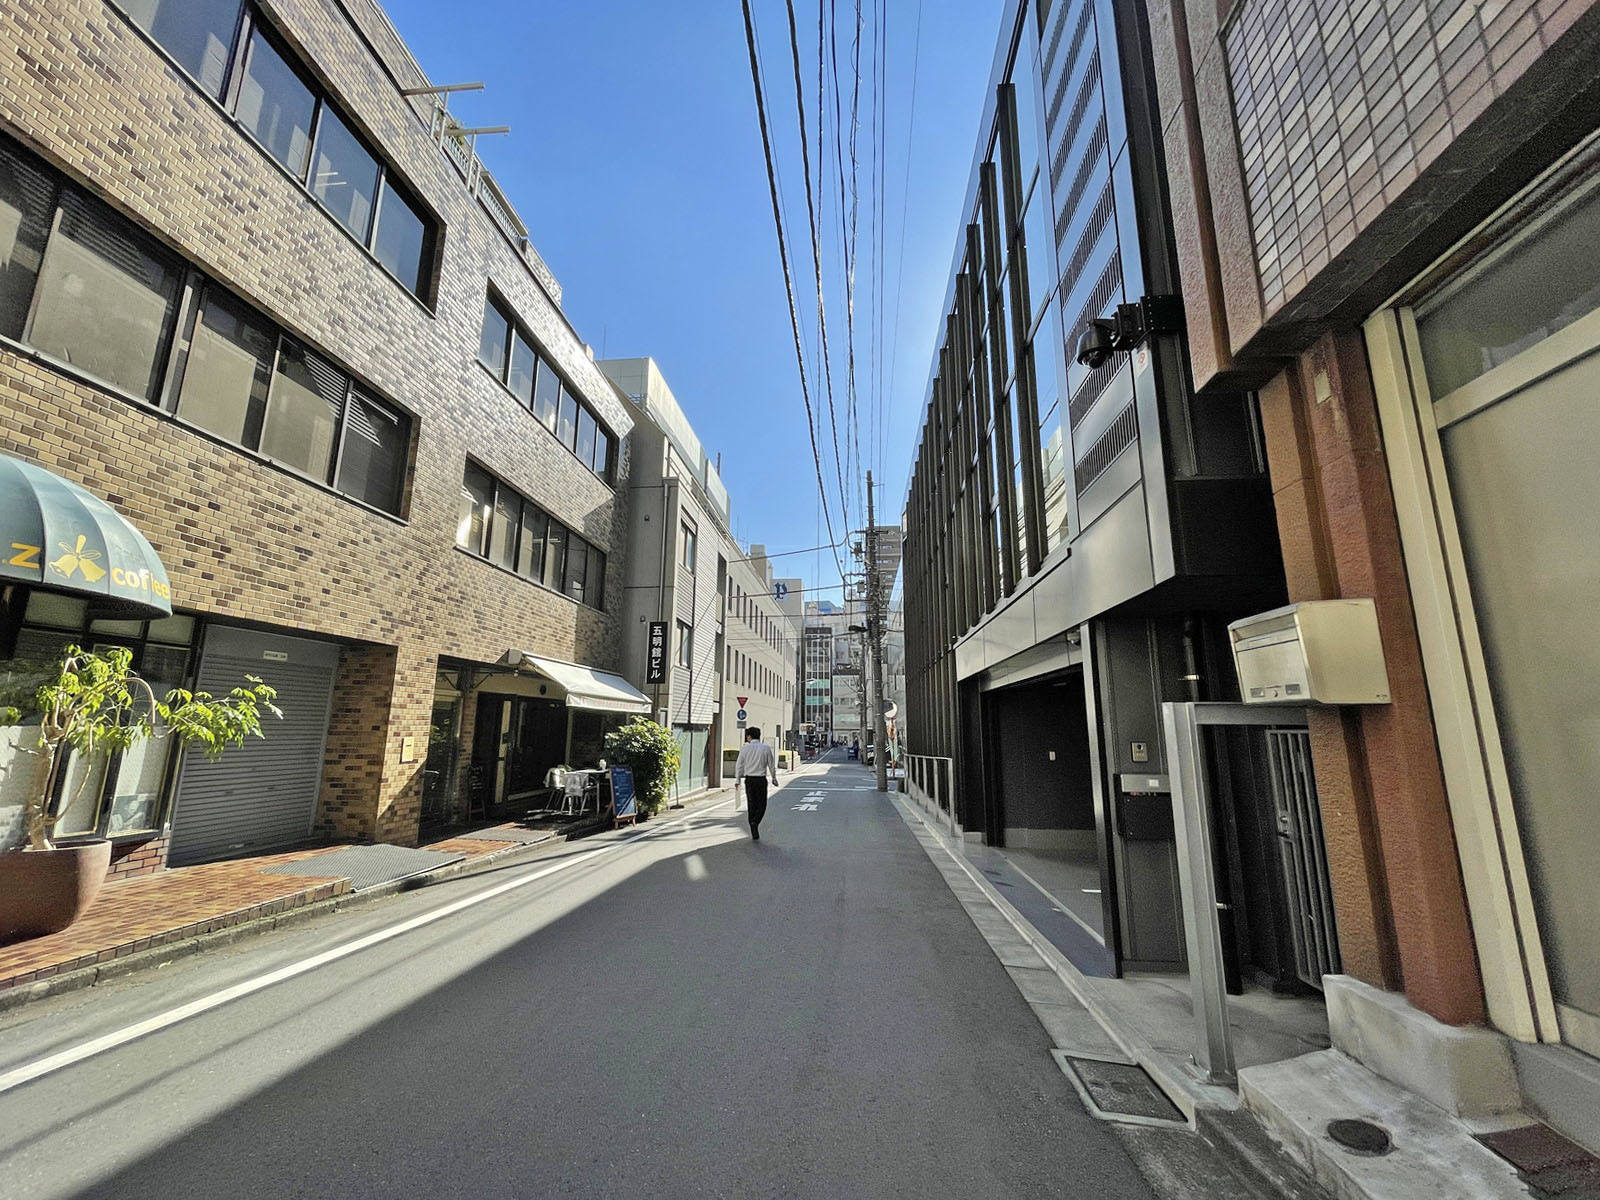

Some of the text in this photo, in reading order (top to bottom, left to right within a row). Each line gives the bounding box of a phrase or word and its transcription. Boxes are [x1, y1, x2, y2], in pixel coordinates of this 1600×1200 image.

[650, 625, 663, 679] 五明館ビル
